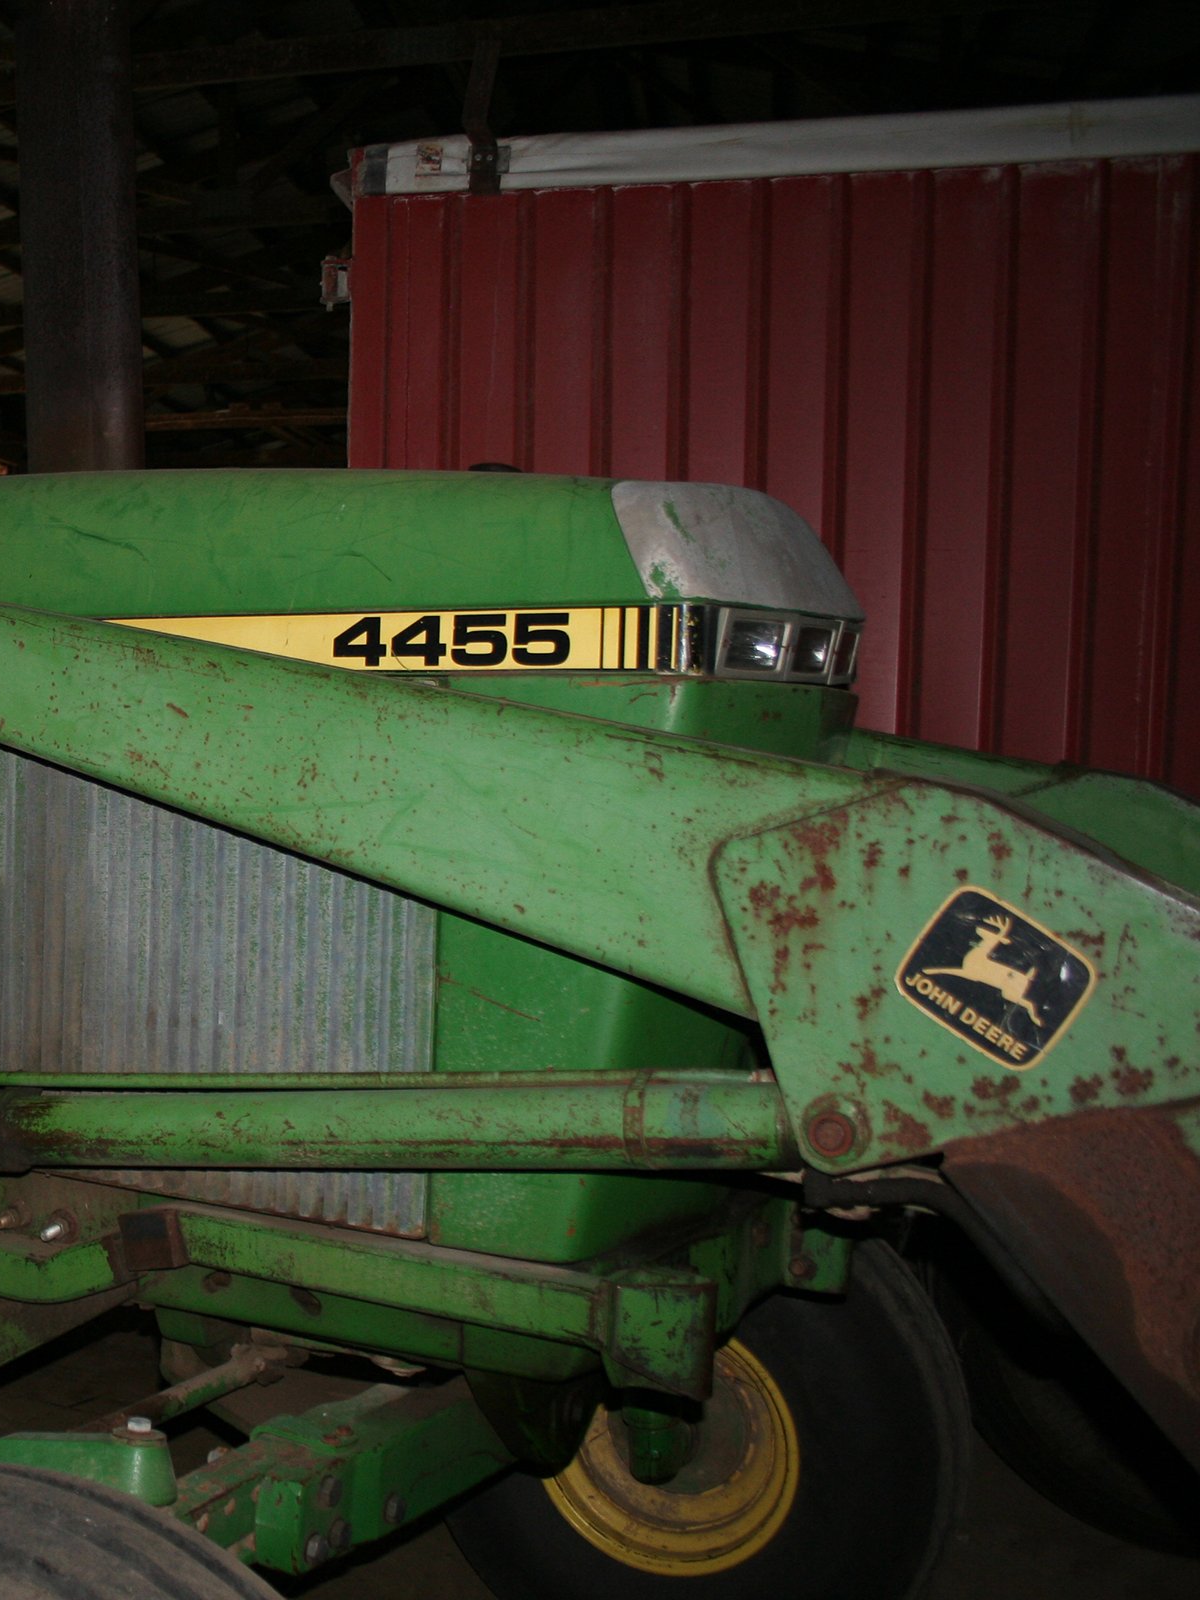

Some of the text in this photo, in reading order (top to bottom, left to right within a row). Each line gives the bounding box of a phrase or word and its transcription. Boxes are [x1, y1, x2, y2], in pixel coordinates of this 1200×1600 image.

[333, 612, 571, 667] 4455
[905, 973, 1028, 1061] JOHN DEERE
